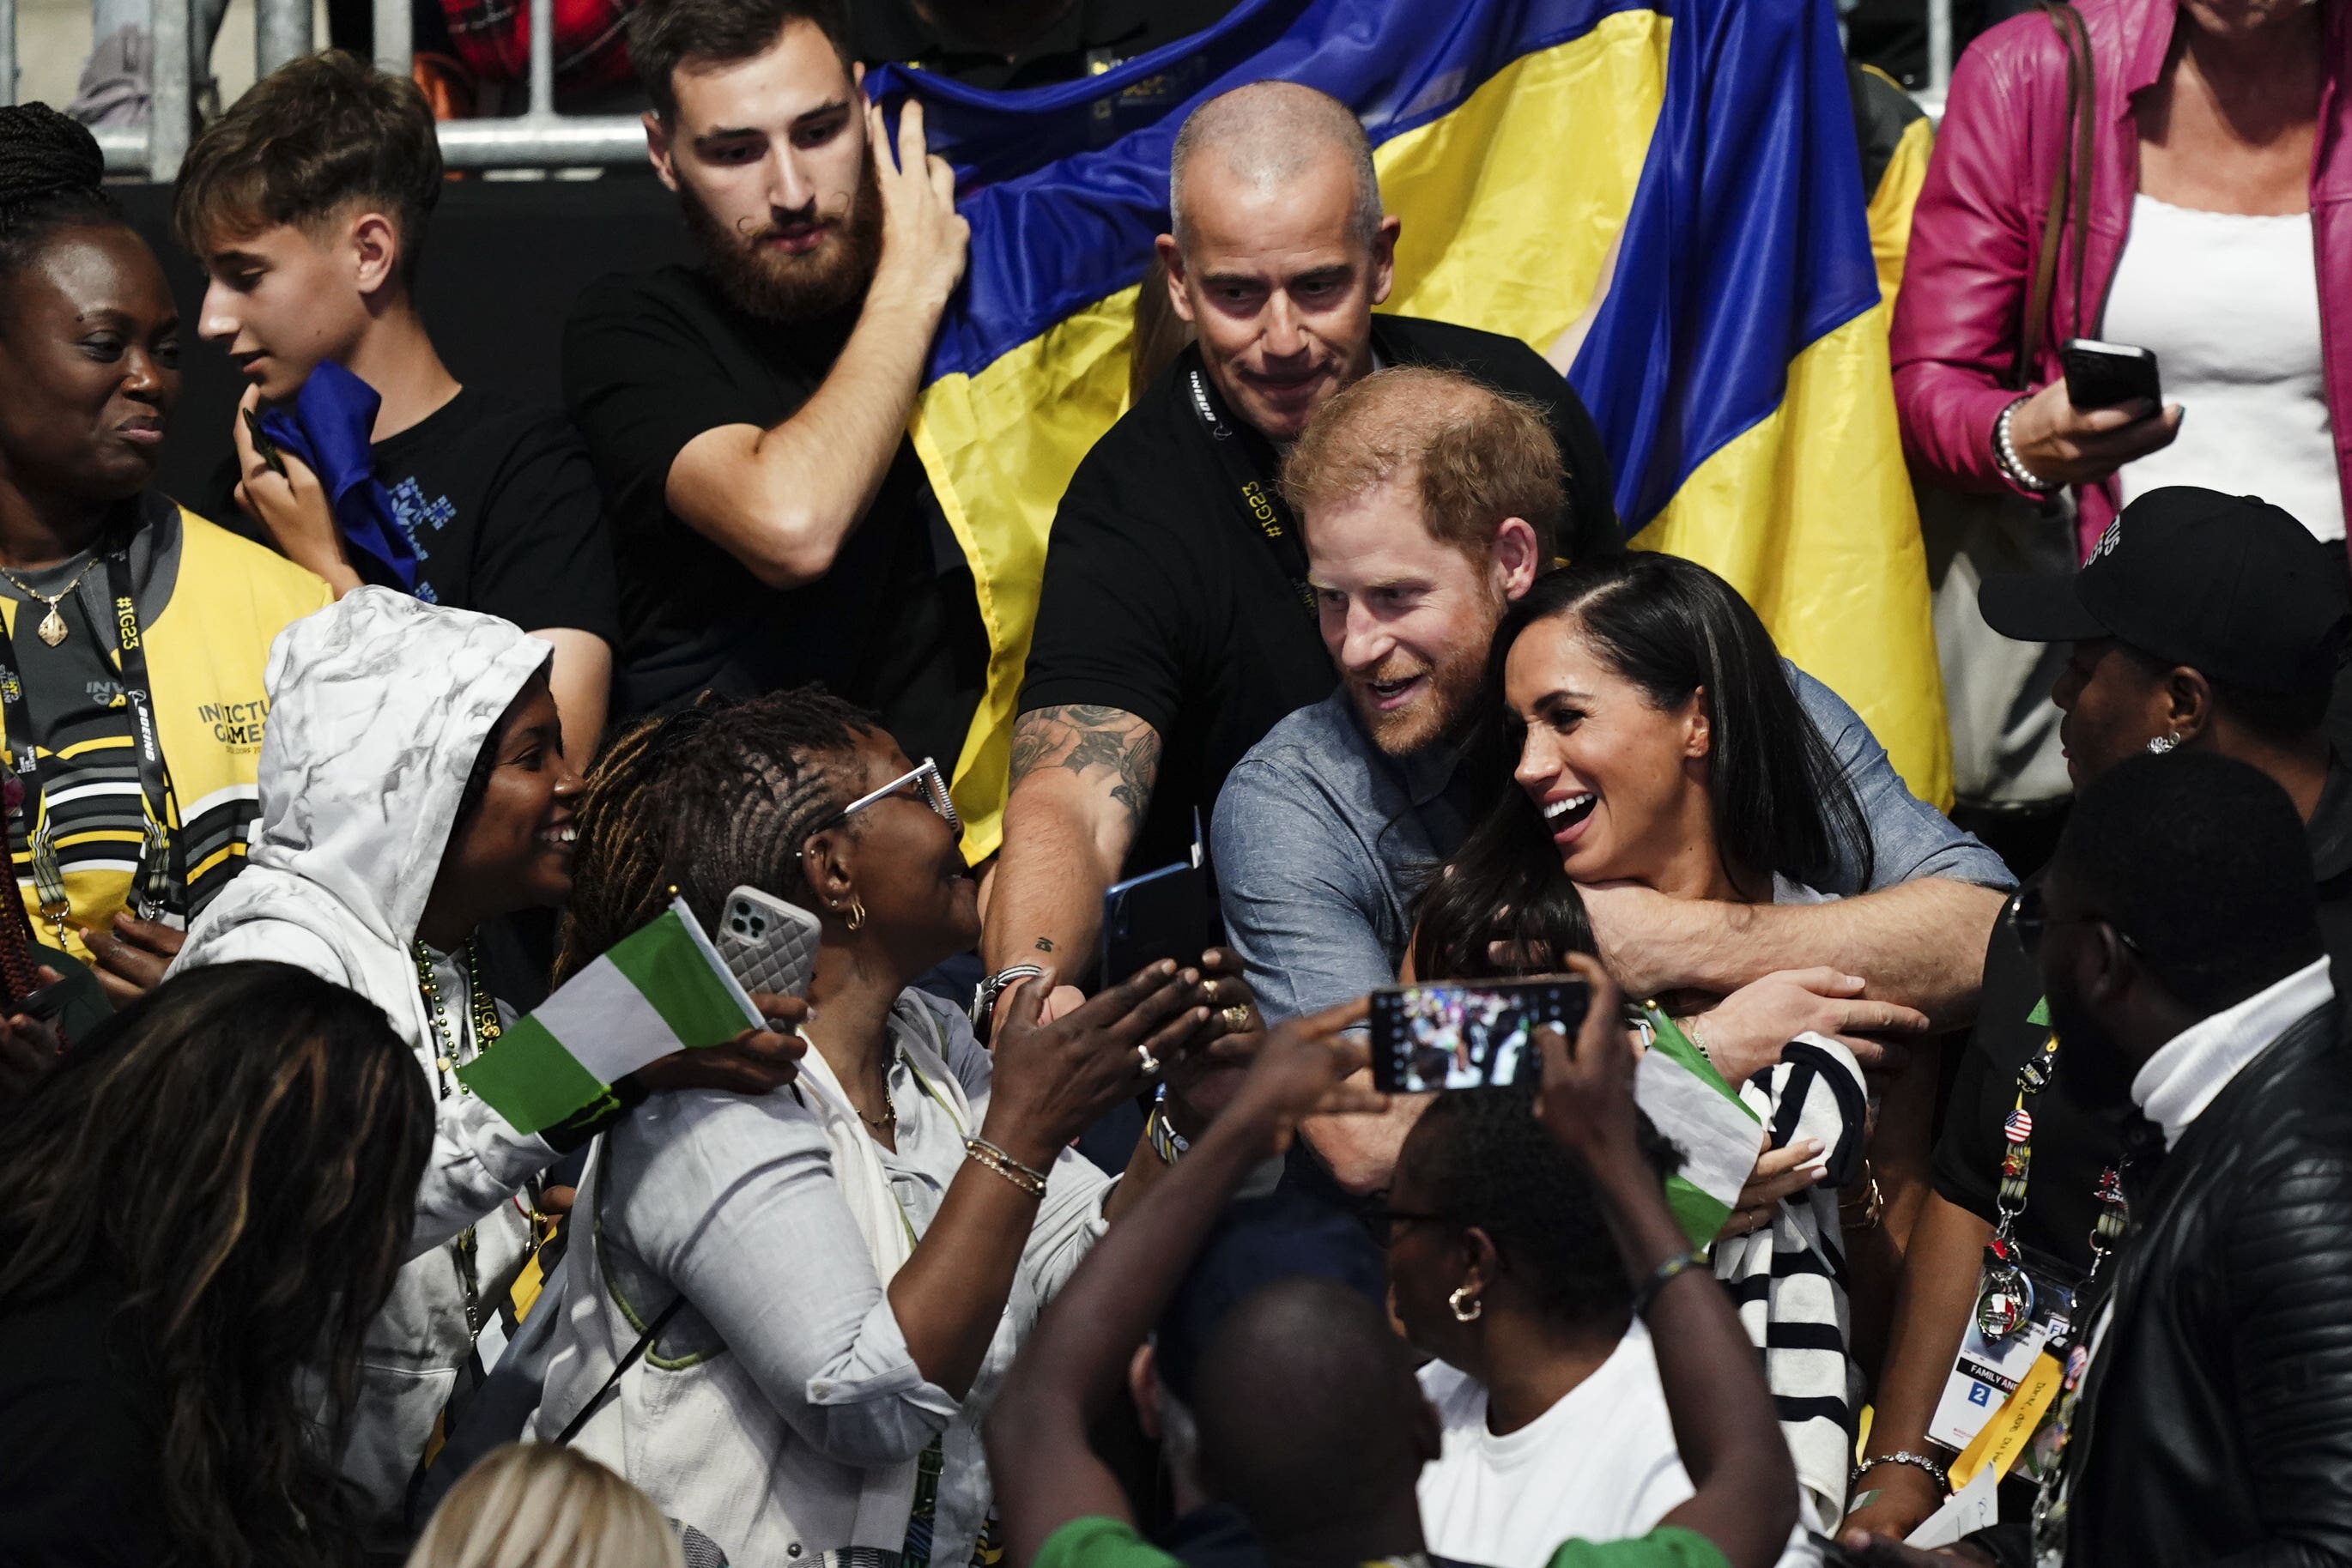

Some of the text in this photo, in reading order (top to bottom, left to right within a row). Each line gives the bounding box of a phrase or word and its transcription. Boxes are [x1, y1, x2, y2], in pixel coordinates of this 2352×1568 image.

[1190, 371, 1216, 421] BOEING
[1241, 481, 1283, 538] #IG23
[117, 596, 139, 651] #IG23
[137, 705, 156, 761] BOEING
[197, 699, 270, 723] INICTU
[1970, 1364, 2002, 1384] FAMILY
[1973, 1387, 1984, 1402] 2
